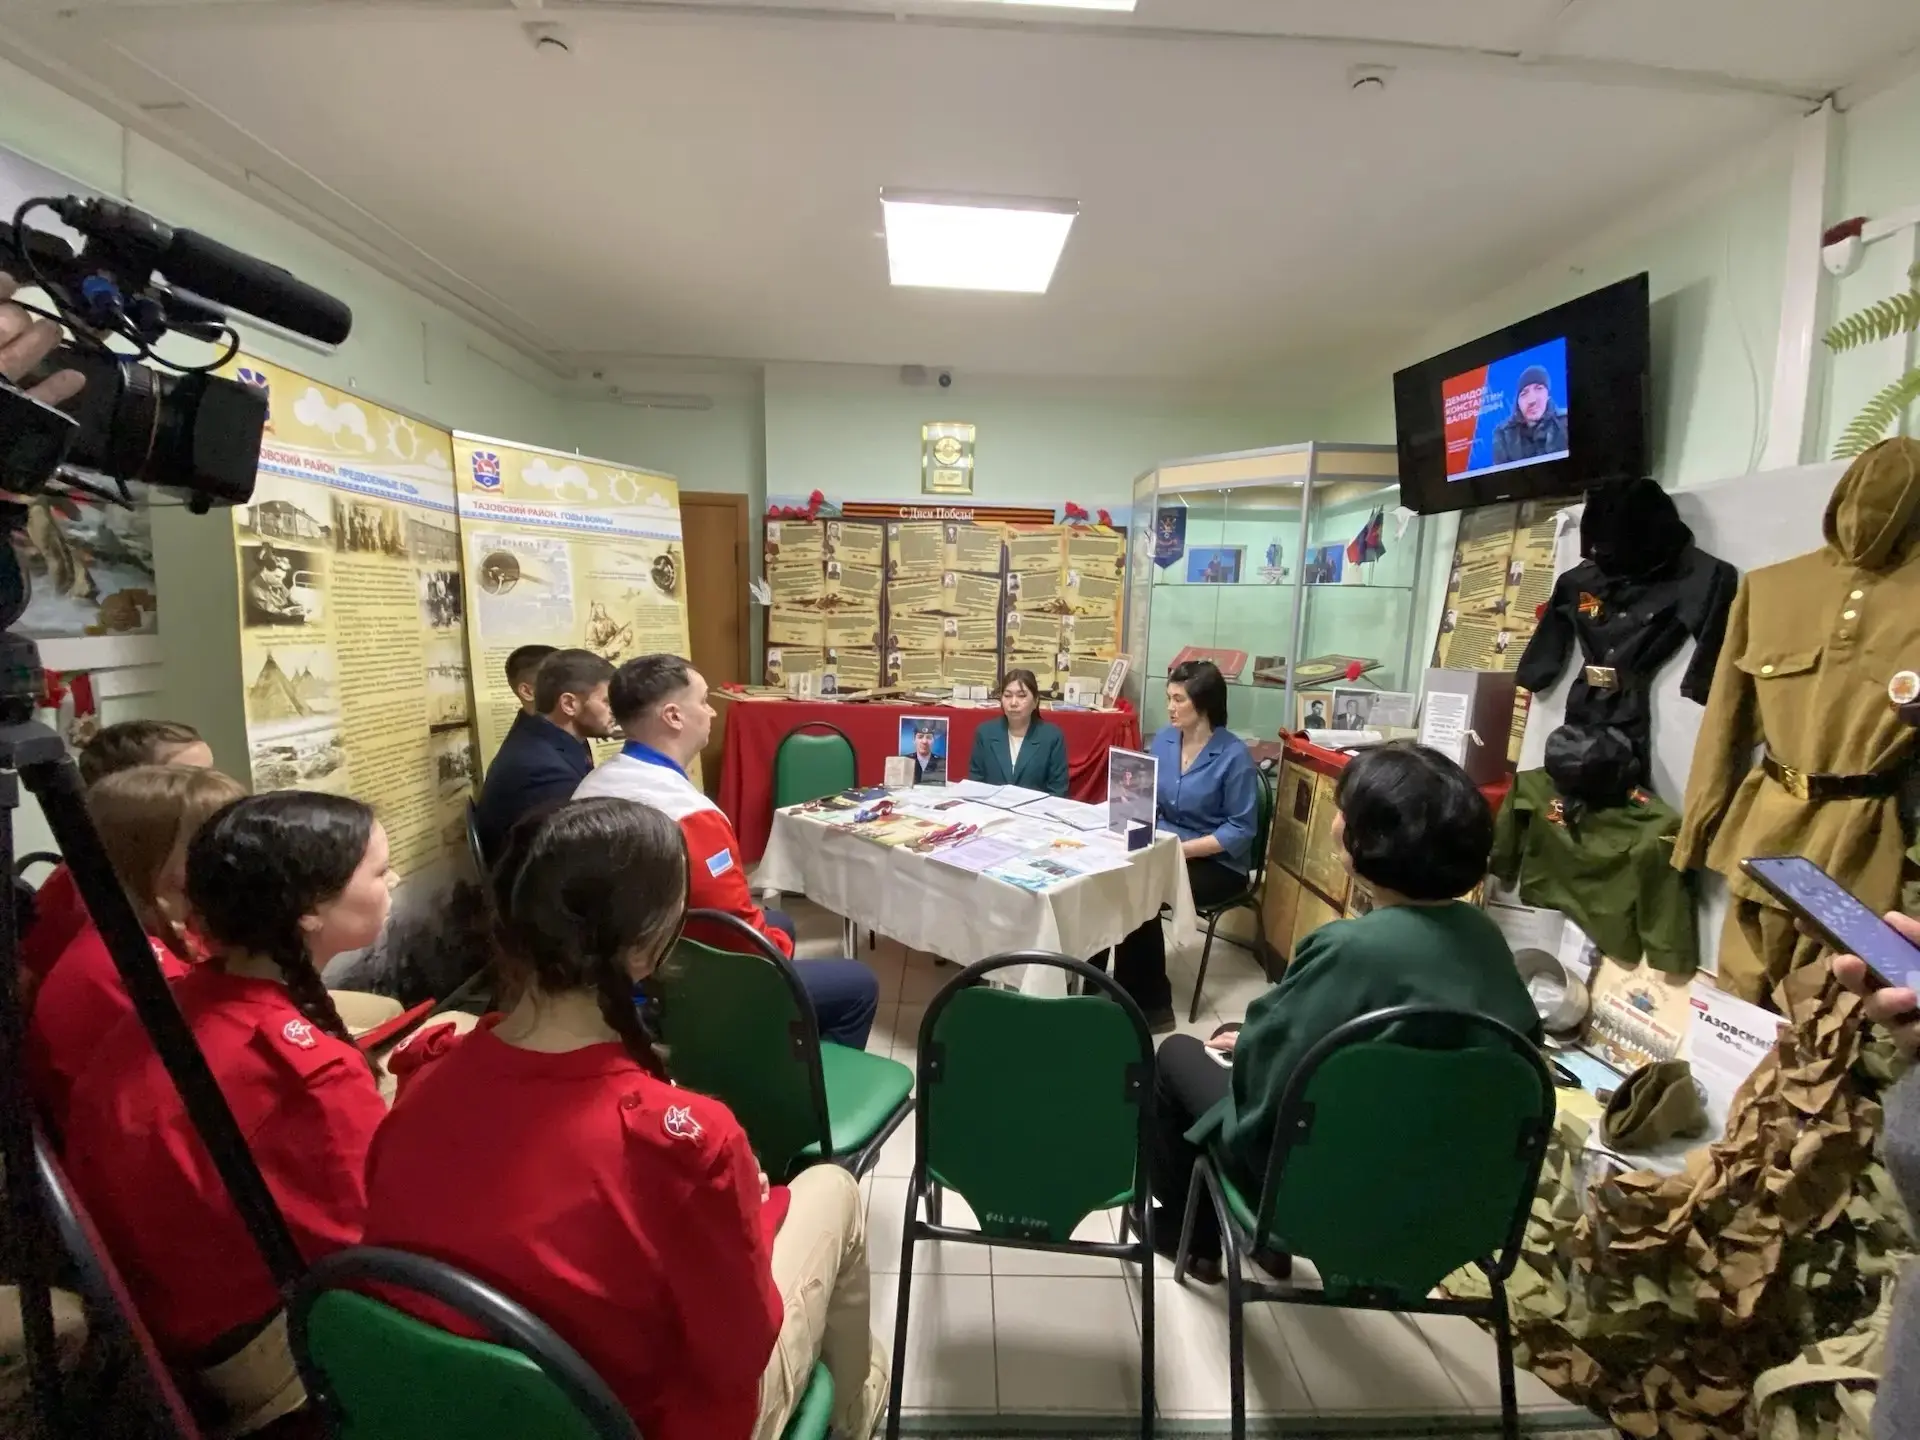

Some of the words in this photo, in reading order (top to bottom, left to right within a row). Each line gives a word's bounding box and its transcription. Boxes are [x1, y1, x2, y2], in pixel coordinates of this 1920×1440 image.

[259, 447, 302, 467] ОВСКИЙ
[472, 501, 527, 515] ТАЗОВСКИЙ
[900, 507, 908, 518] С
[936, 507, 975, 520] Победы!
